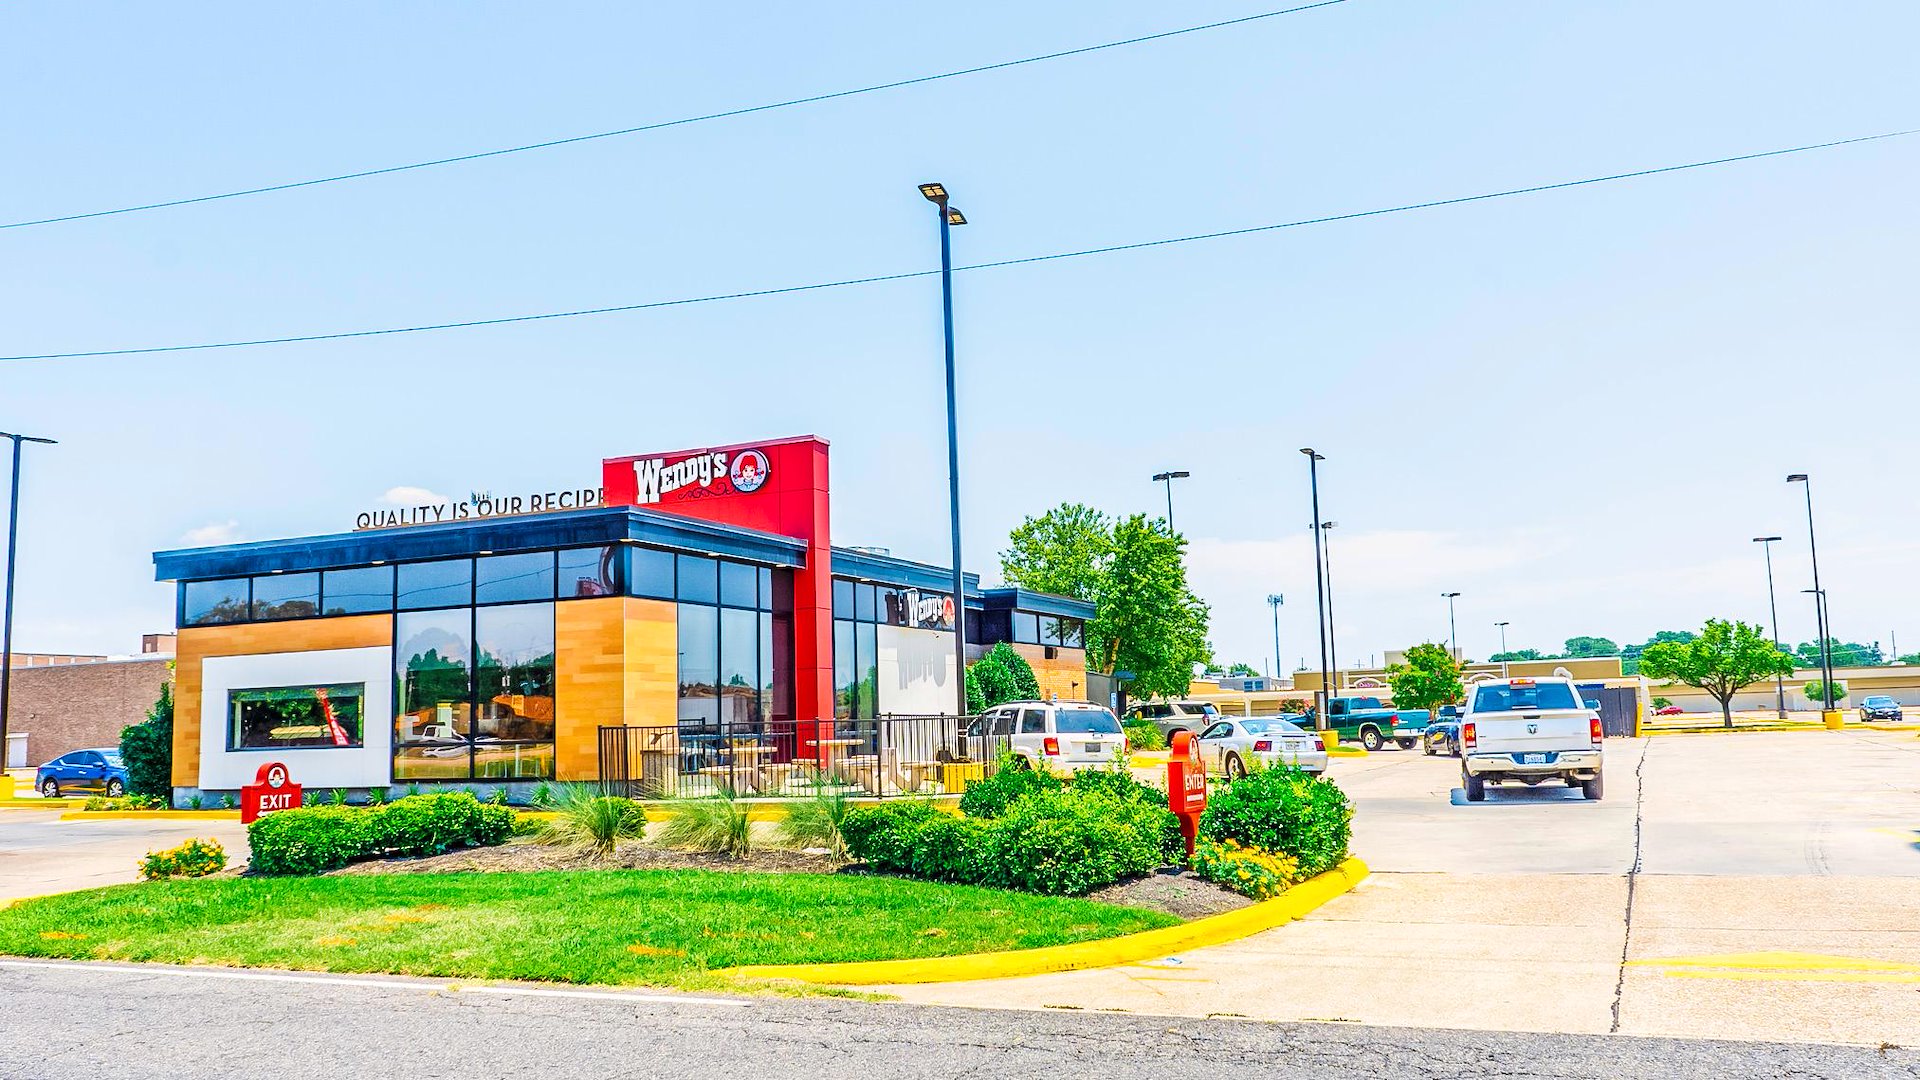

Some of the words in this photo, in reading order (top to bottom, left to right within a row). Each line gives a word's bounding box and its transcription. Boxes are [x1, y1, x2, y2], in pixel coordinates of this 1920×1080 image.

[357, 504, 445, 528] QUALITY
[453, 502, 469, 520] IS
[477, 497, 522, 516] OUR
[1185, 773, 1205, 791] ENTER
[259, 794, 292, 809] EXIT
